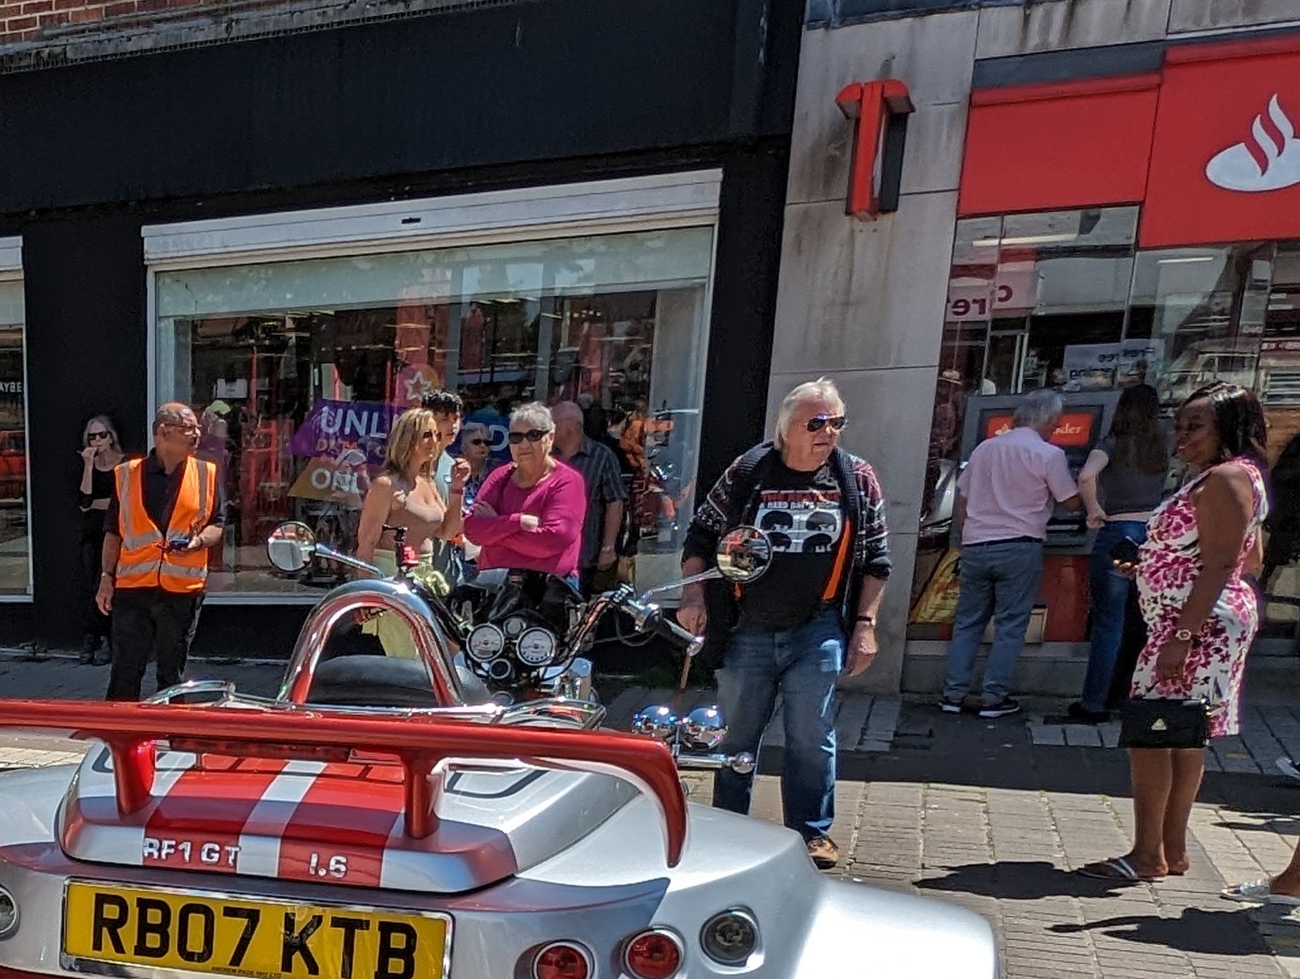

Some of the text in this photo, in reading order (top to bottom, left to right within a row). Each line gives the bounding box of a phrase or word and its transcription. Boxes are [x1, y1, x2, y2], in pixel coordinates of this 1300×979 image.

[143, 837, 192, 863] RF1
[200, 842, 242, 867] GT
[92, 892, 261, 968] RB07
